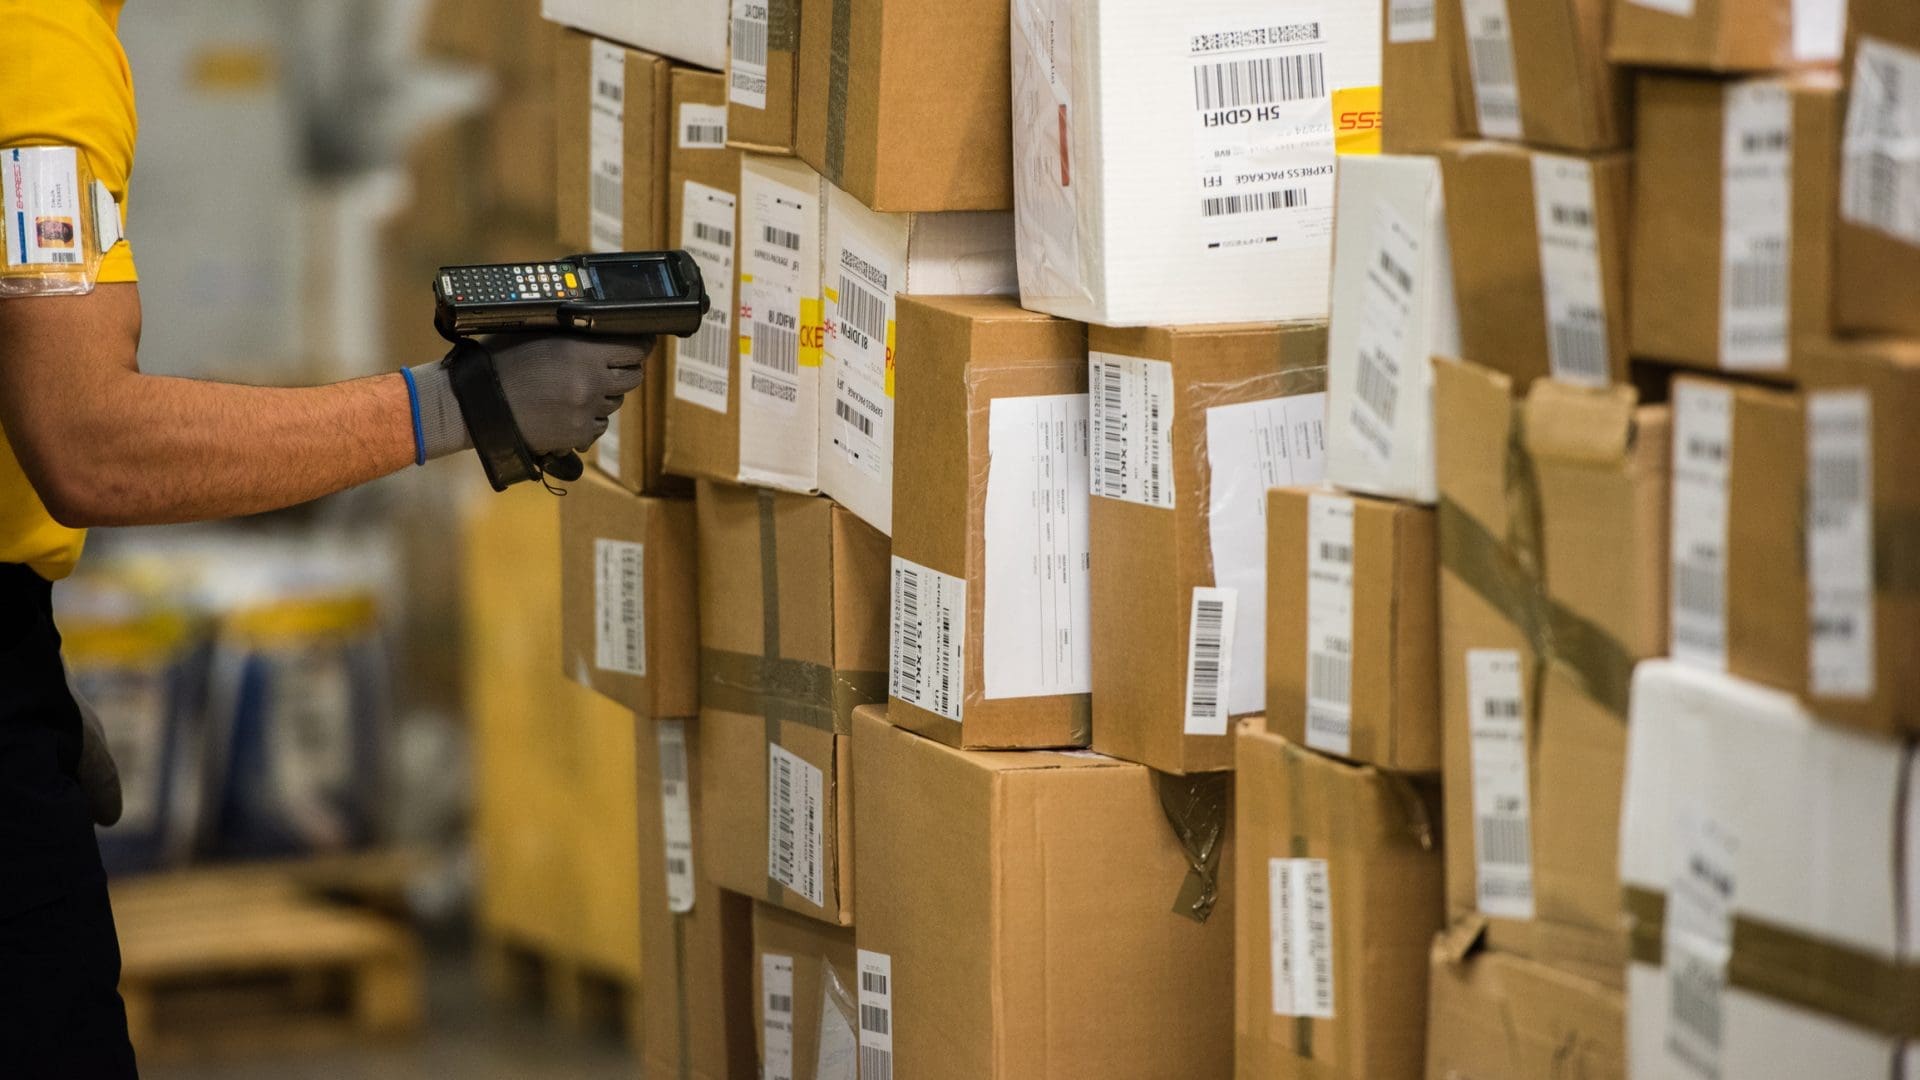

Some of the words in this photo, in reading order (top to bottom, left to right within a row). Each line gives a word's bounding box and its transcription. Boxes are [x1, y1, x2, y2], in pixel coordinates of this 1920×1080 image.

[1204, 109, 1252, 127] GDIFI
[1257, 105, 1280, 121] 5H
[1236, 171, 1285, 184] PACKAGE
[1287, 164, 1334, 179] EXPRESS
[1203, 175, 1223, 188] FFI
[775, 311, 797, 330] JDIFW
[840, 322, 861, 345] JDIFW
[916, 621, 923, 639] 1S
[915, 644, 923, 701] FXKLB
